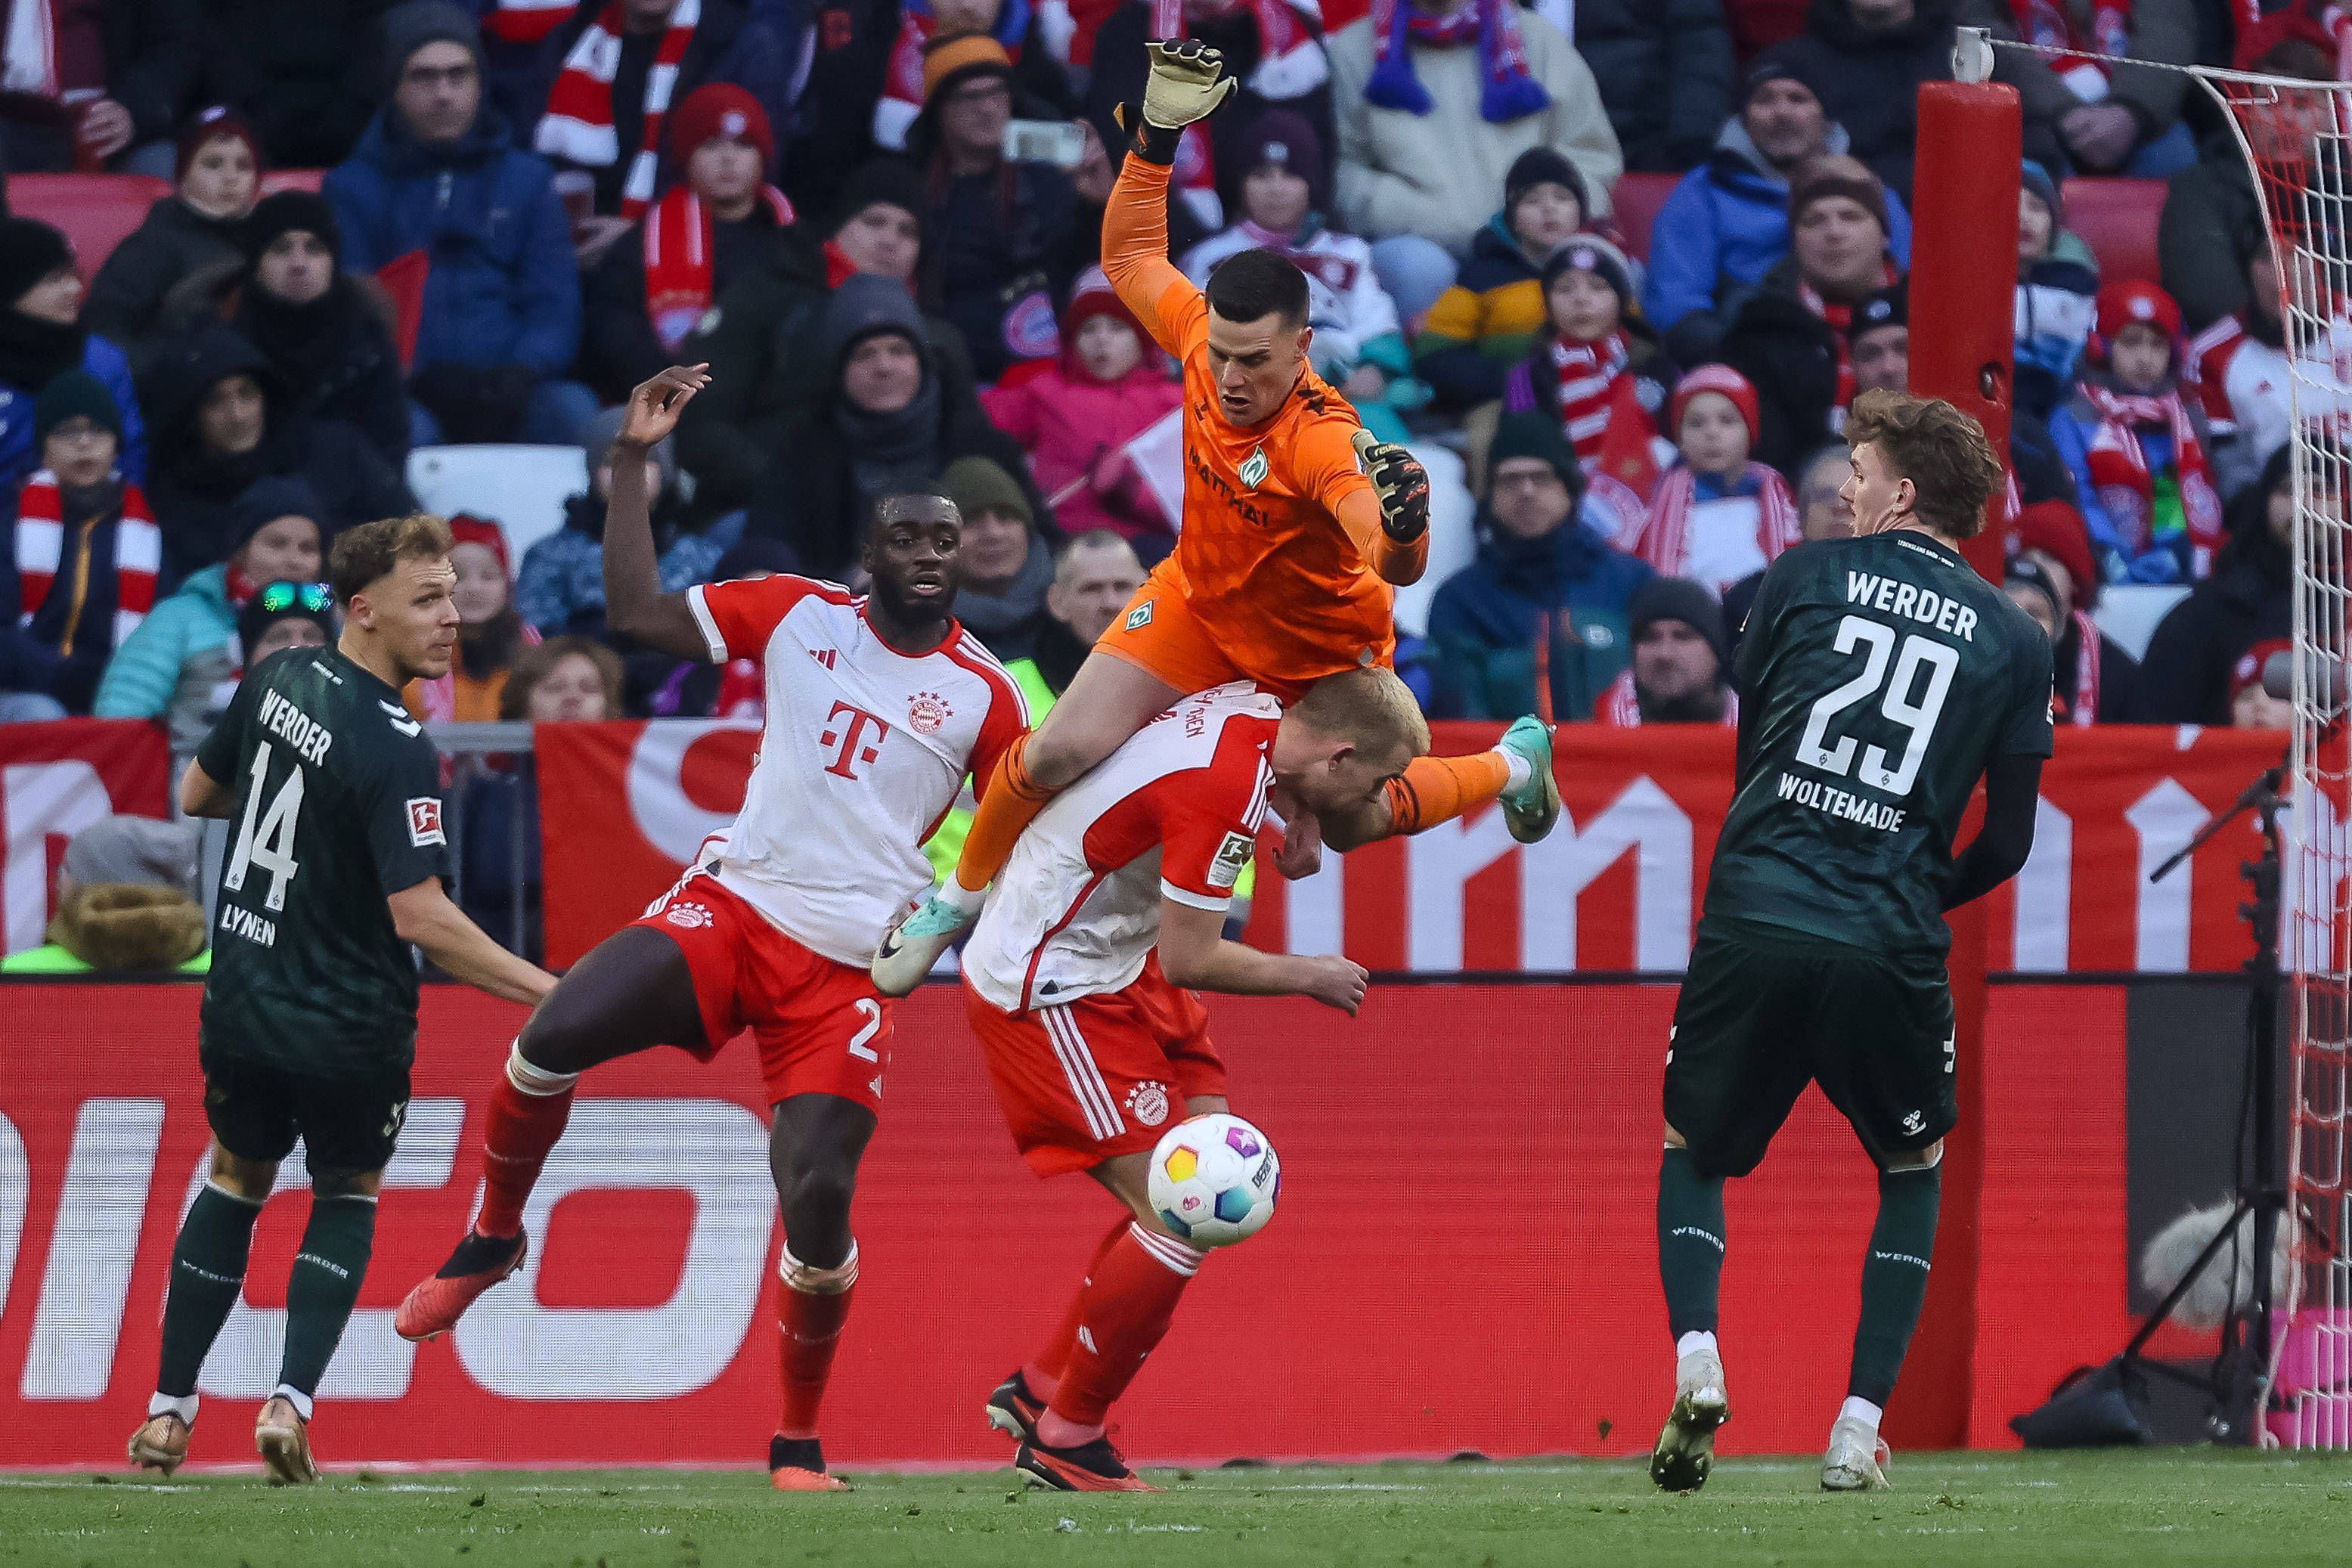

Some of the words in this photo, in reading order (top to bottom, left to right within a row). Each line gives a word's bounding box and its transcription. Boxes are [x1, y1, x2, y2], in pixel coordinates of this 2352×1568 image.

[1848, 571, 1978, 642] WERDER
[259, 687, 333, 767] WERDER
[1796, 615, 1960, 796] 29
[224, 740, 305, 912] 14
[1777, 772, 1907, 832] WOLTEMADE
[220, 903, 276, 948] LYNEN
[848, 997, 881, 1064] 2
[0, 1096, 779, 1399] ICO
